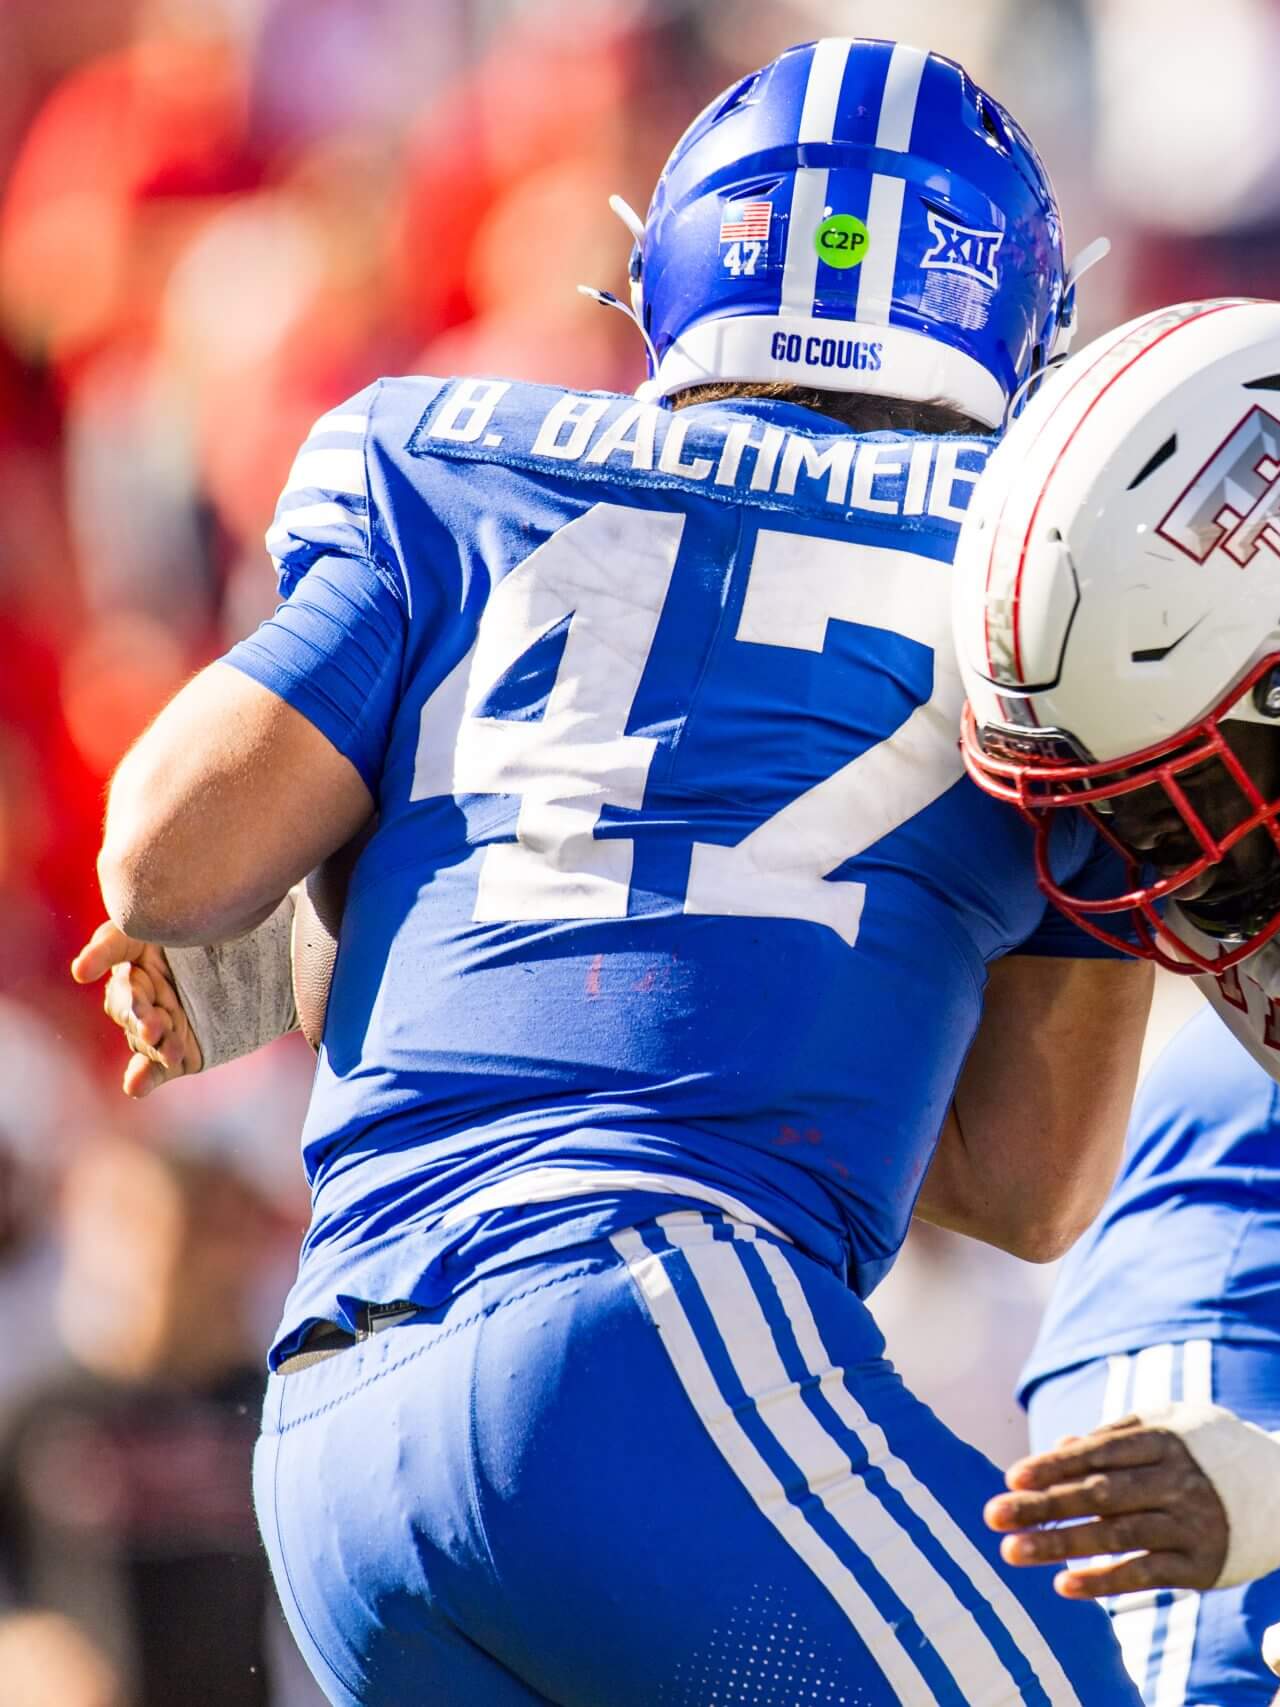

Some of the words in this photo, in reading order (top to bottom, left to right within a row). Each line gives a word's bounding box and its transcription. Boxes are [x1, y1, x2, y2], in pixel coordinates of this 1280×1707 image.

[723, 241, 762, 276] 47
[821, 231, 865, 251] C2P
[771, 331, 802, 363] GO
[805, 336, 883, 371] COUGS
[428, 379, 511, 447] B.
[409, 502, 970, 947] 47
